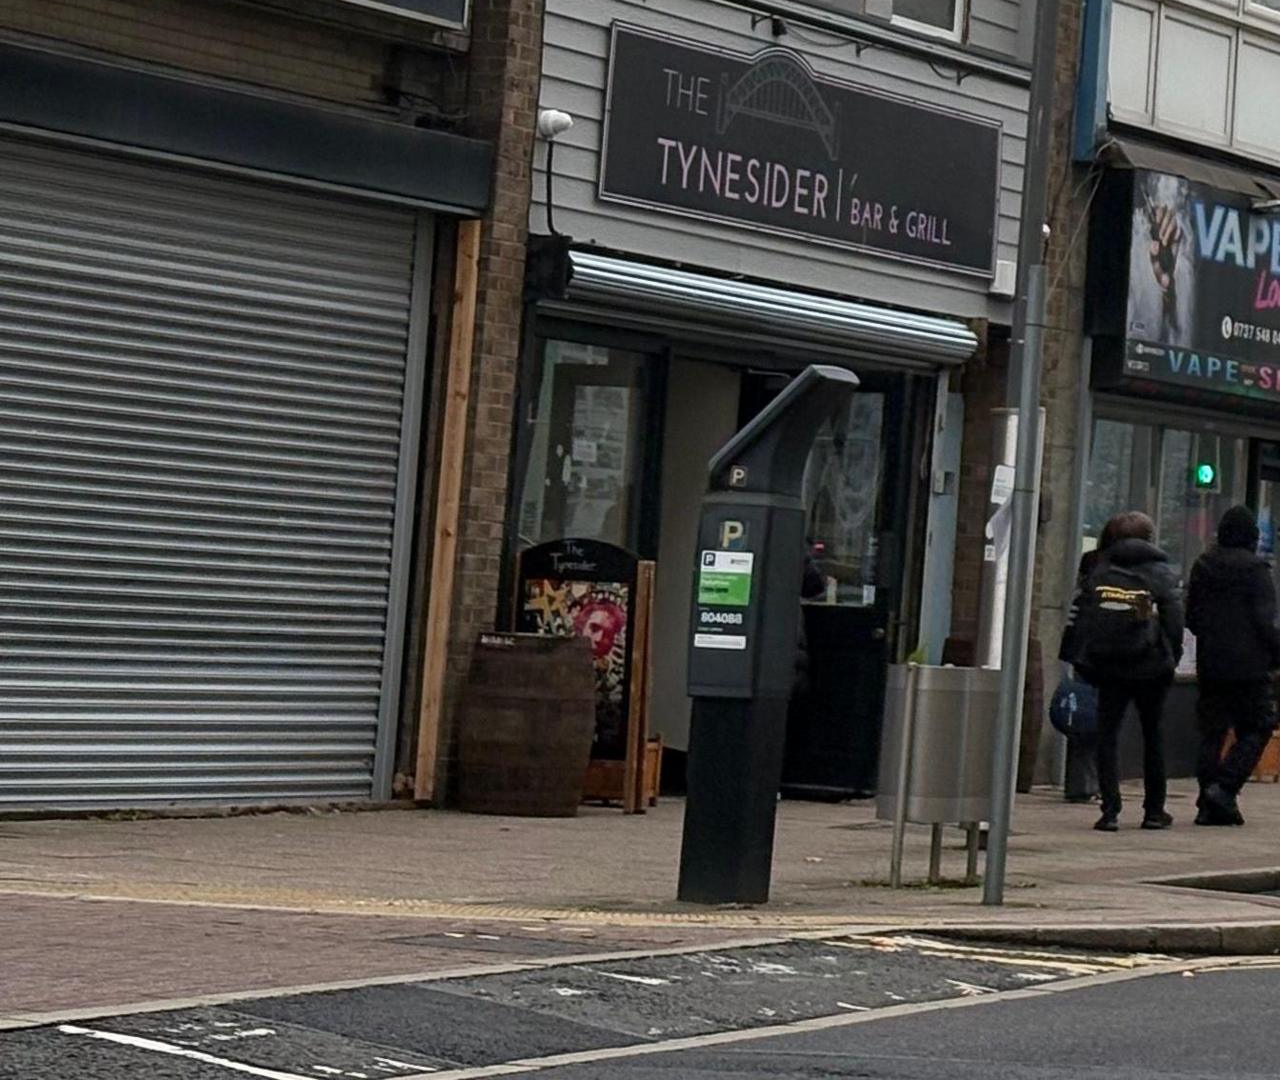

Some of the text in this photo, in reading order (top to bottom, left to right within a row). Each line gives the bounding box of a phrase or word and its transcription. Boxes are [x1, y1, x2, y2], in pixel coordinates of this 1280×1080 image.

[663, 68, 711, 116] THE
[657, 137, 830, 219] TYNESIDER
[851, 197, 952, 246] BAR & GRILL
[1168, 349, 1240, 383] VAPE
[732, 468, 745, 484] P
[722, 520, 744, 548] P
